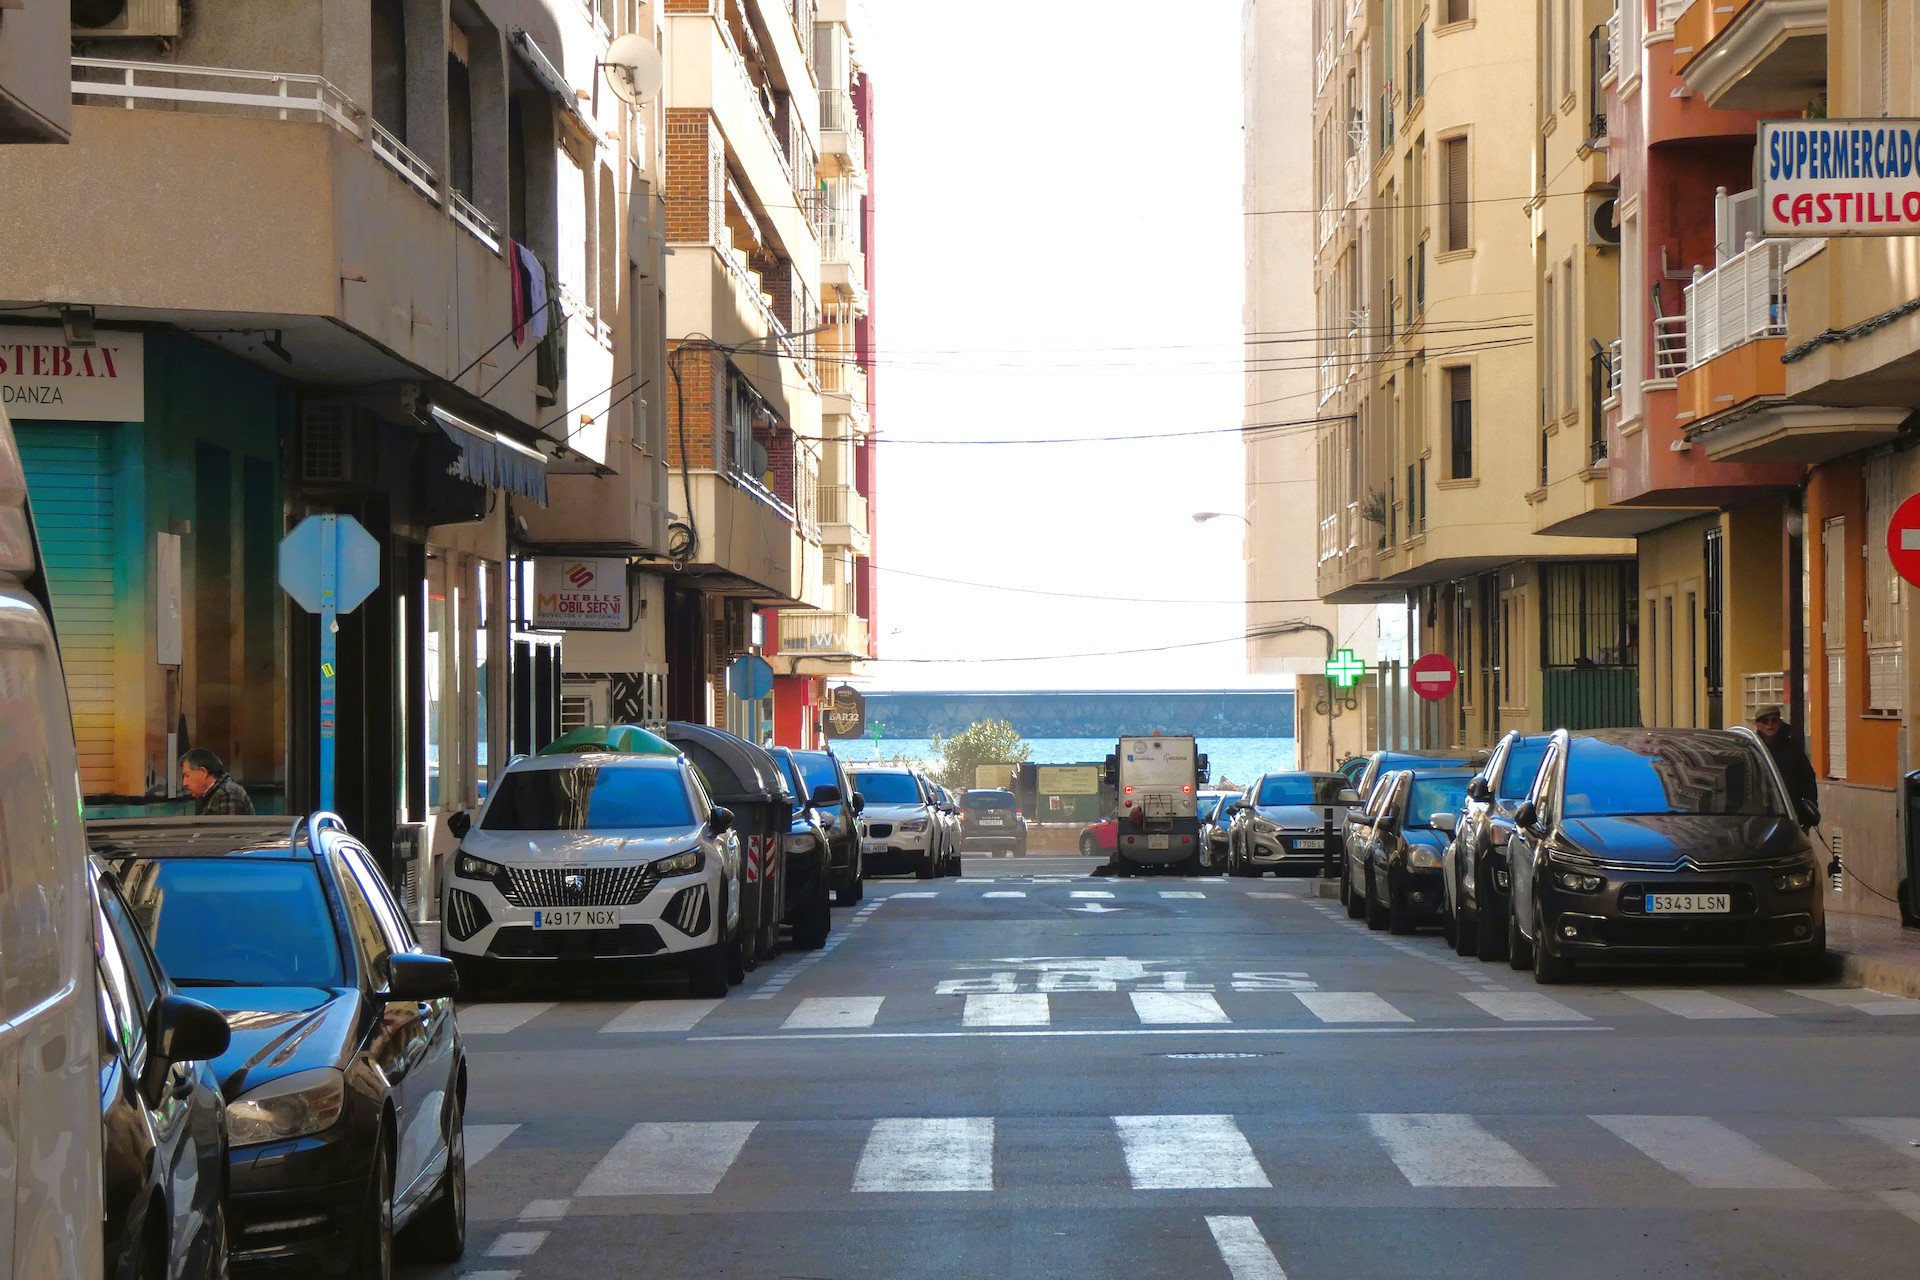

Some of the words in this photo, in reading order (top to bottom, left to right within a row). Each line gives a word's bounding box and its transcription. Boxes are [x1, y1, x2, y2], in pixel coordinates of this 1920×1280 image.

[1772, 191, 1920, 227] CASTILLO
[3, 385, 63, 404] DANZA
[1655, 896, 1692, 910] 5343
[1697, 896, 1725, 910] LSN
[544, 912, 581, 926] 4917
[586, 911, 615, 925] NGX
